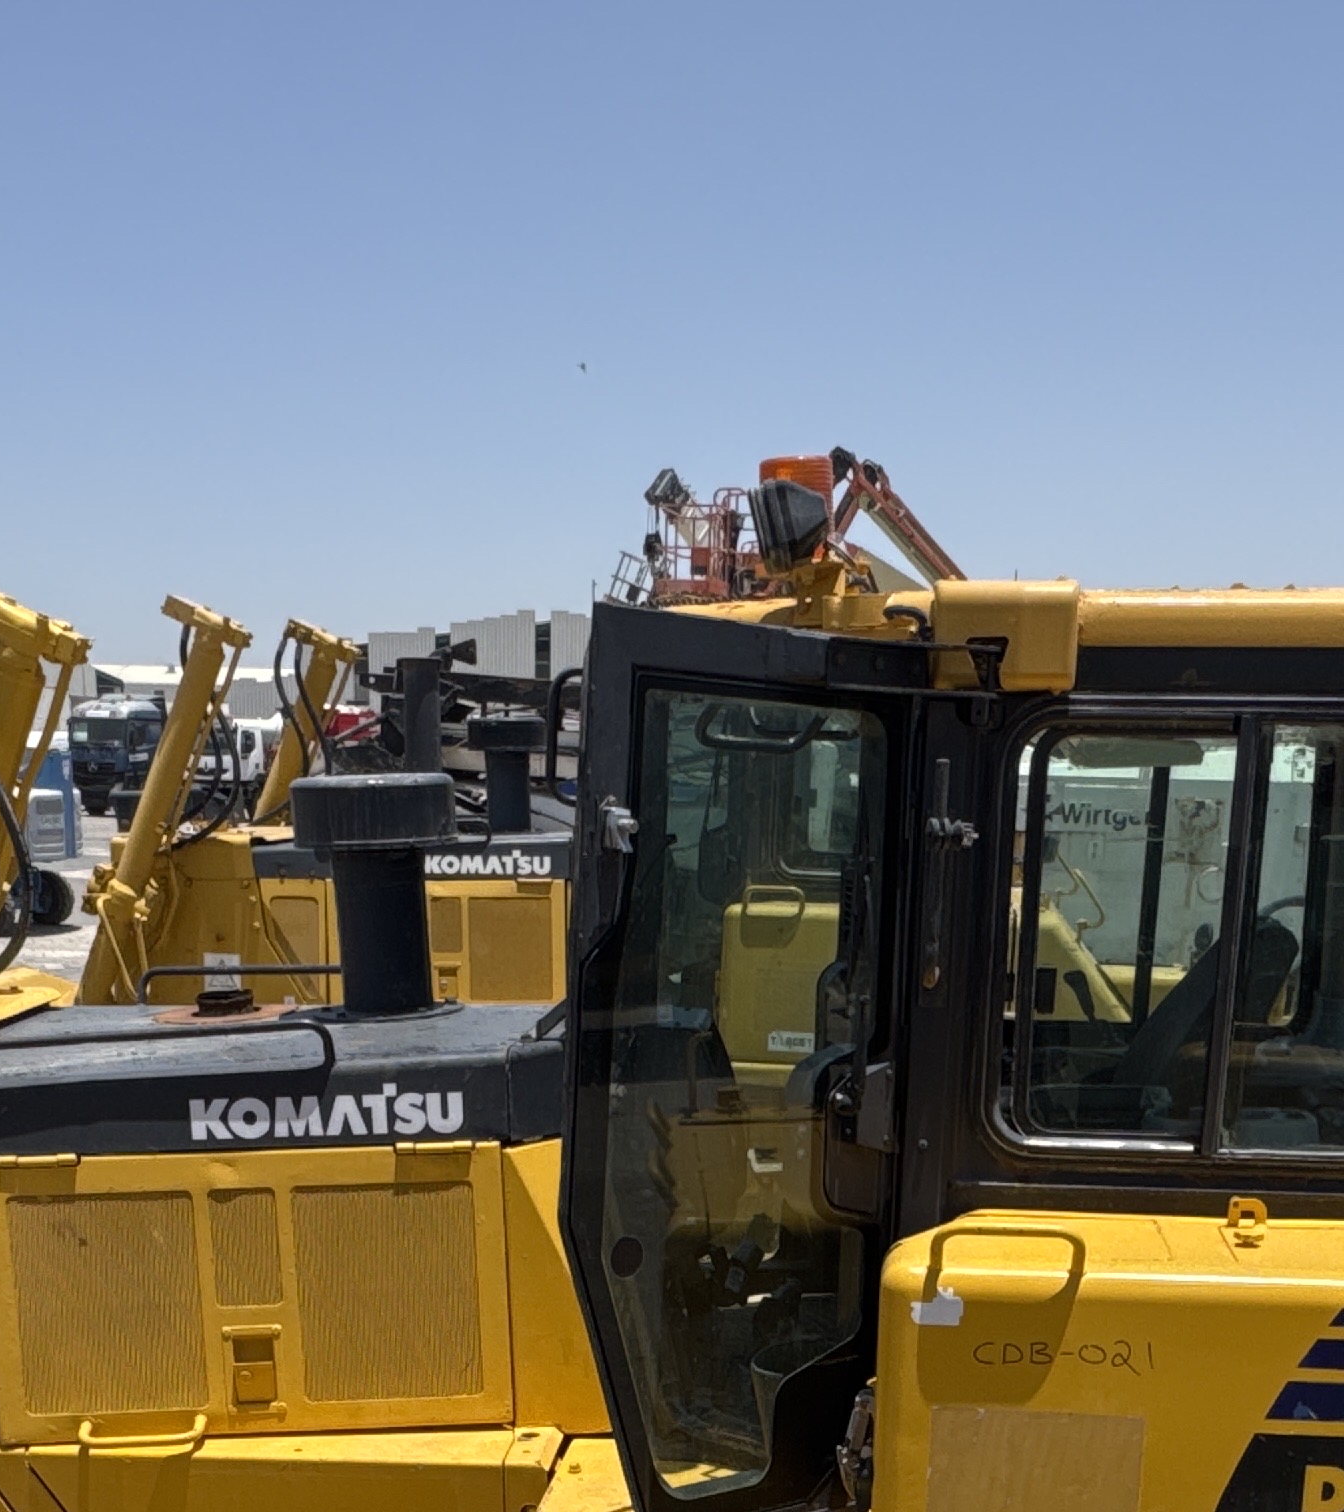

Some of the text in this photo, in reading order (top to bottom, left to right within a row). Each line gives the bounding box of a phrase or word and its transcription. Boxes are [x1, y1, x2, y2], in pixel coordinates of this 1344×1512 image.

[424, 849, 552, 875] KOMATSU
[188, 1082, 464, 1141] KOMATSU
[972, 1339, 1155, 1376] CDB-021
